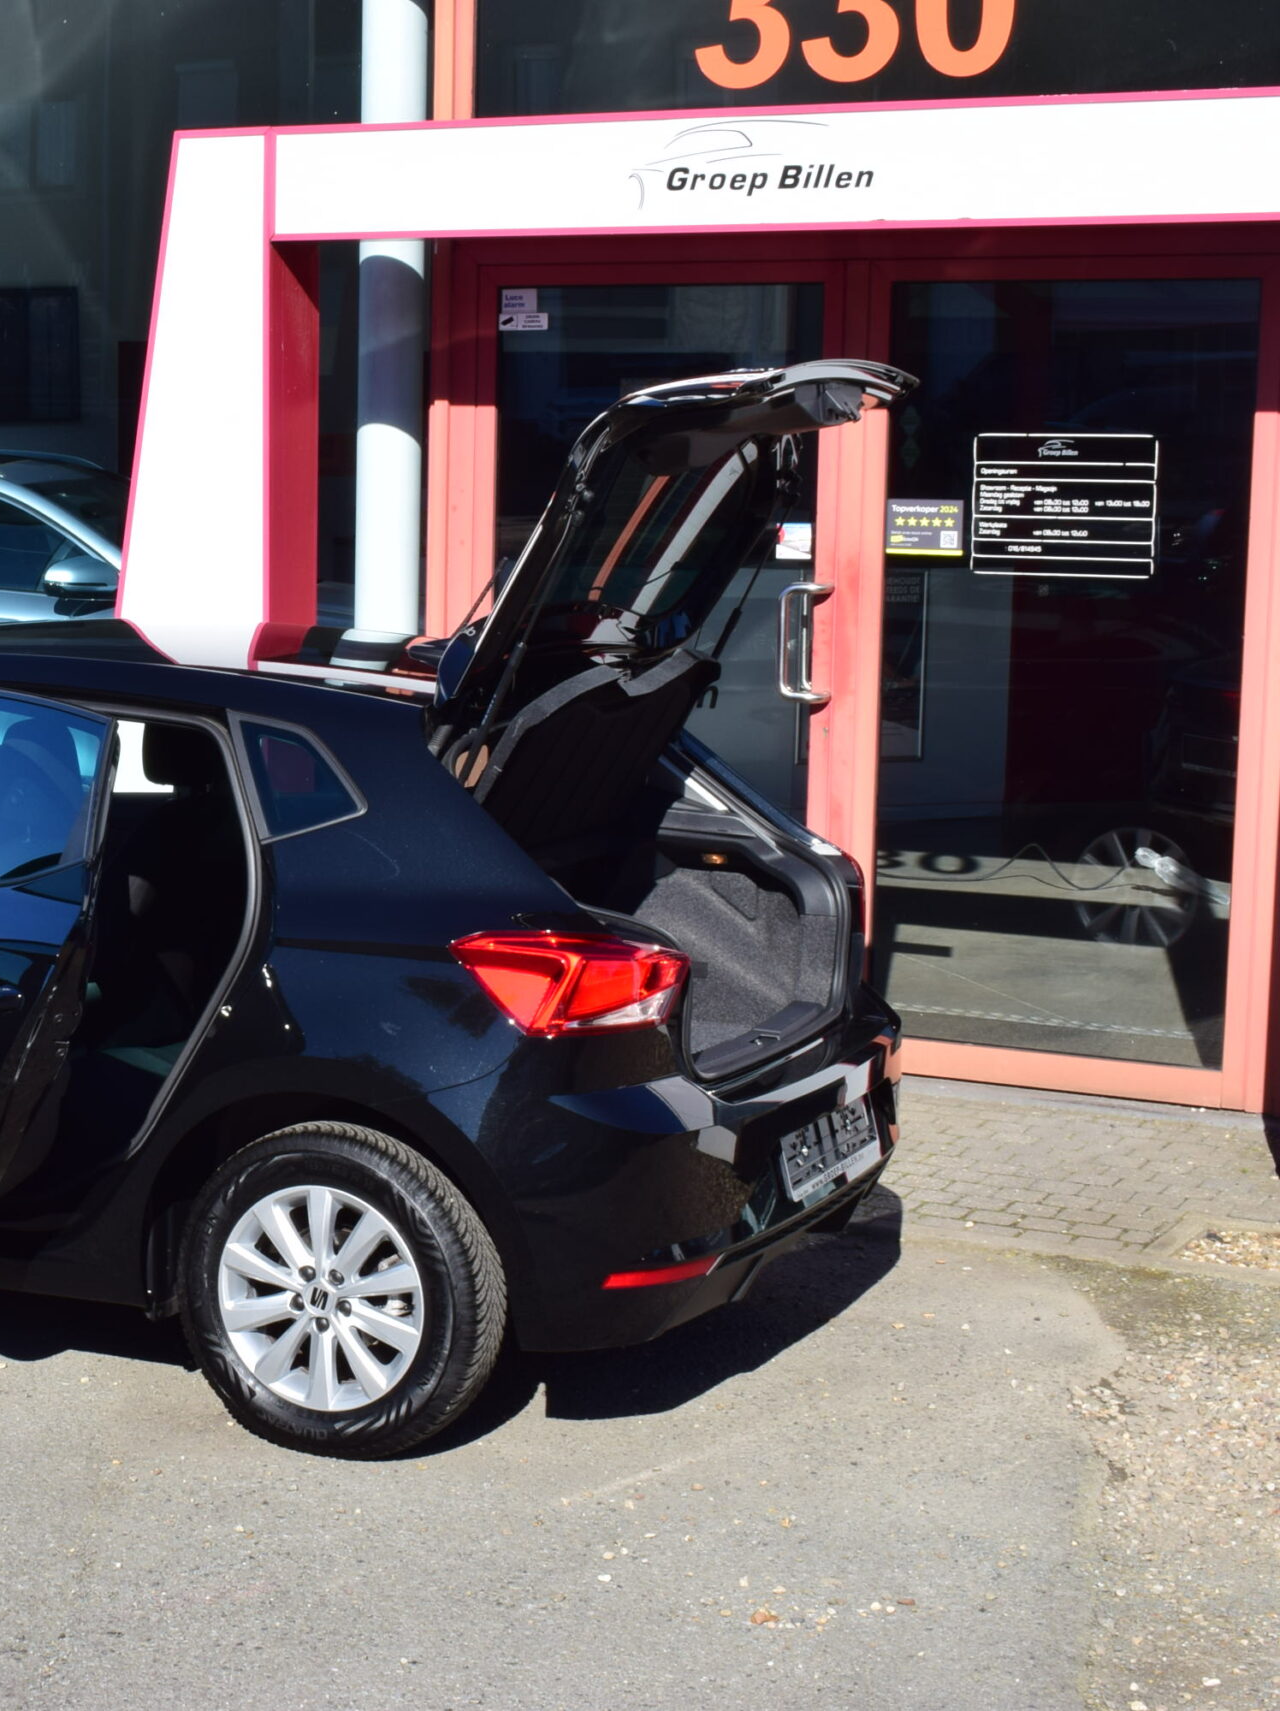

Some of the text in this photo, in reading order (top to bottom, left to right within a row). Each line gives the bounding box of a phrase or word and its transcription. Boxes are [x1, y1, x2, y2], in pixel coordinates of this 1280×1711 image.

[666, 164, 874, 197] Groep Billen
[891, 504, 959, 514] Topverkoper 2024
